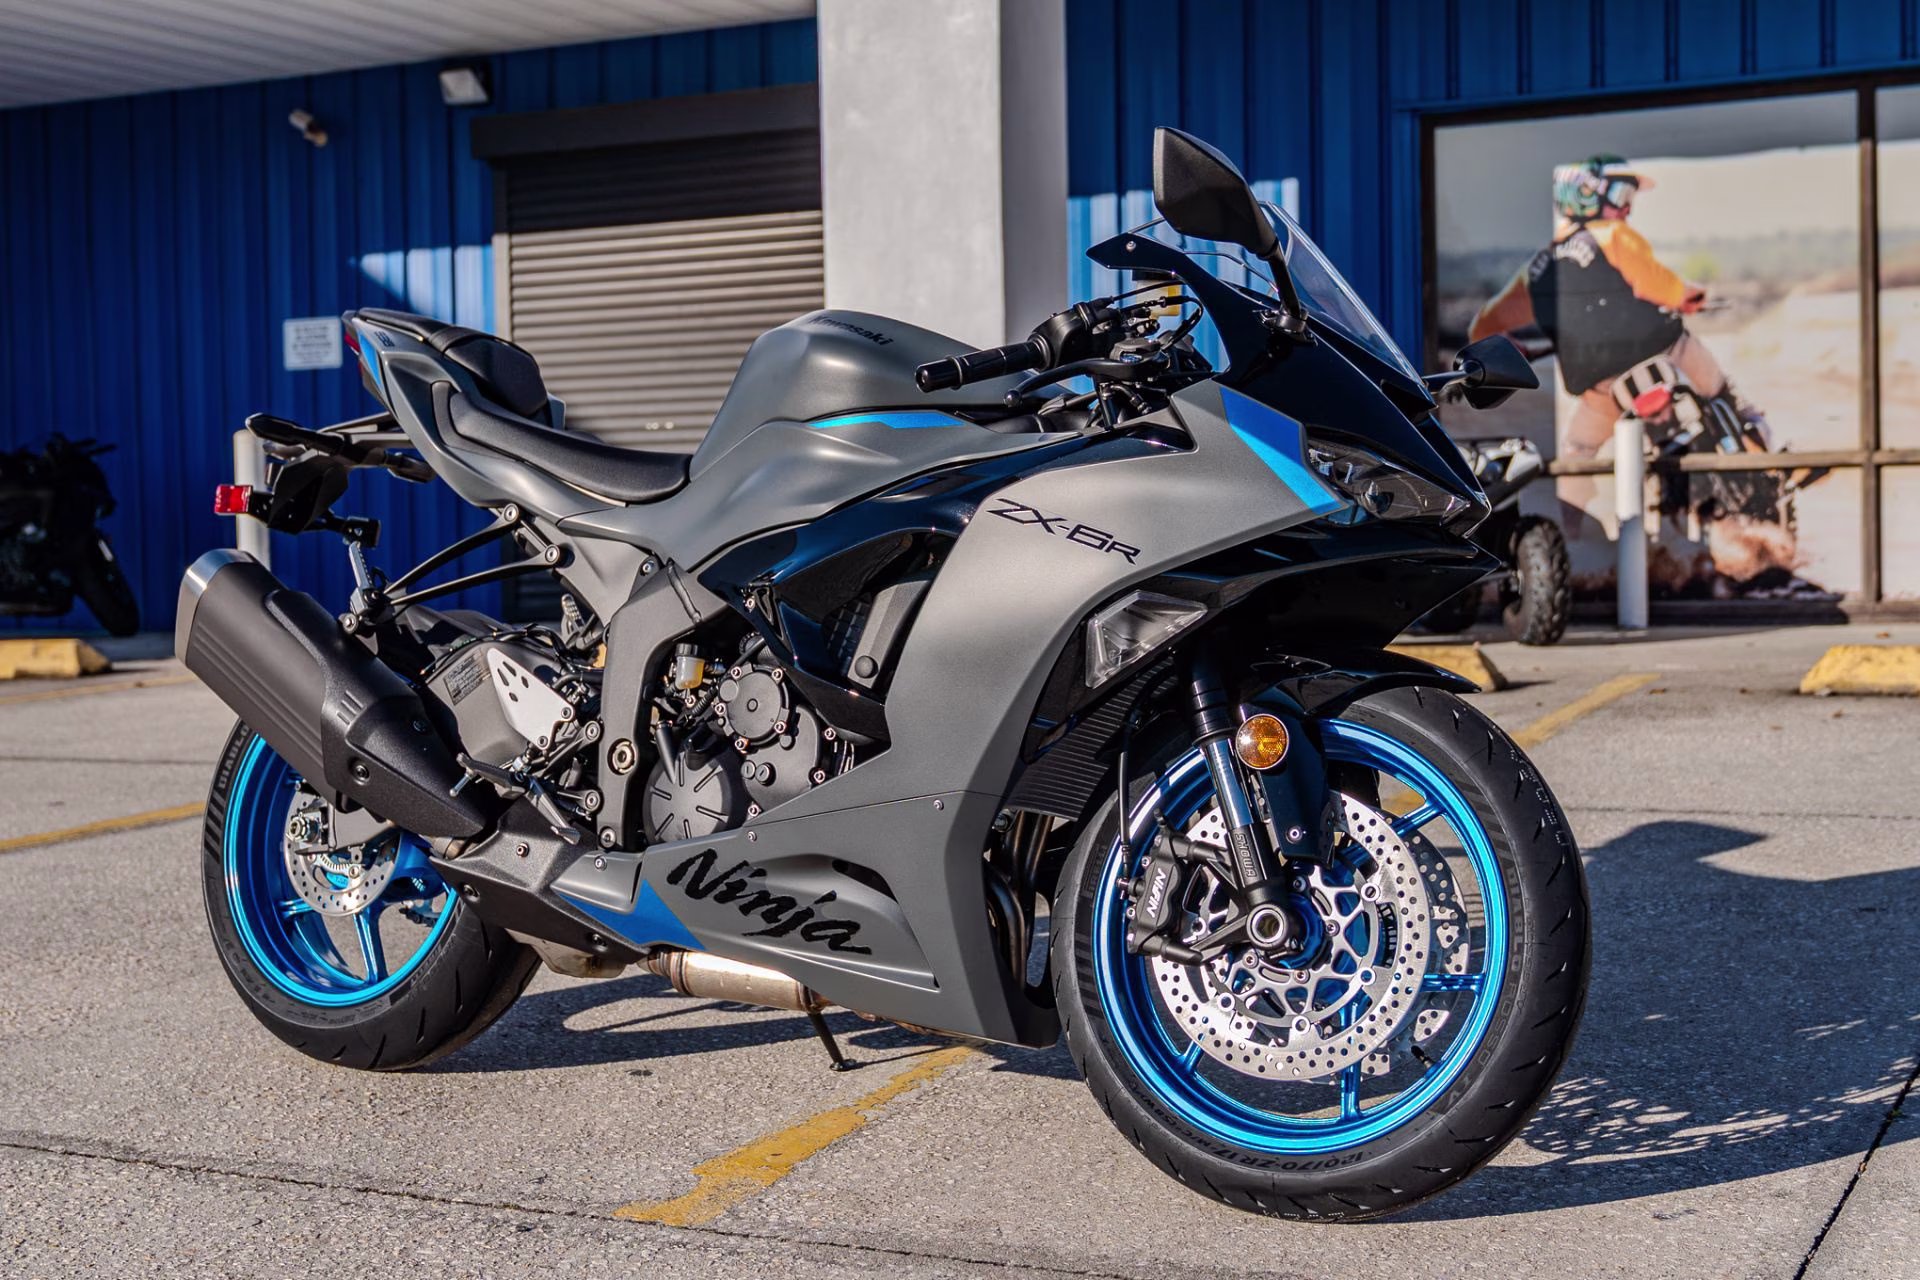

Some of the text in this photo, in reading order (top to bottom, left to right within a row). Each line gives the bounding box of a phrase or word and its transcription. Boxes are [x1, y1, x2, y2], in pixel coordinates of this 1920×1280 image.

[985, 498, 1142, 566] ZX-6R
[1235, 833, 1257, 877] SHOWA
[666, 848, 873, 955] Ninja
[1506, 867, 1523, 972] DIABLO
[1477, 982, 1518, 1068] ROSSO
